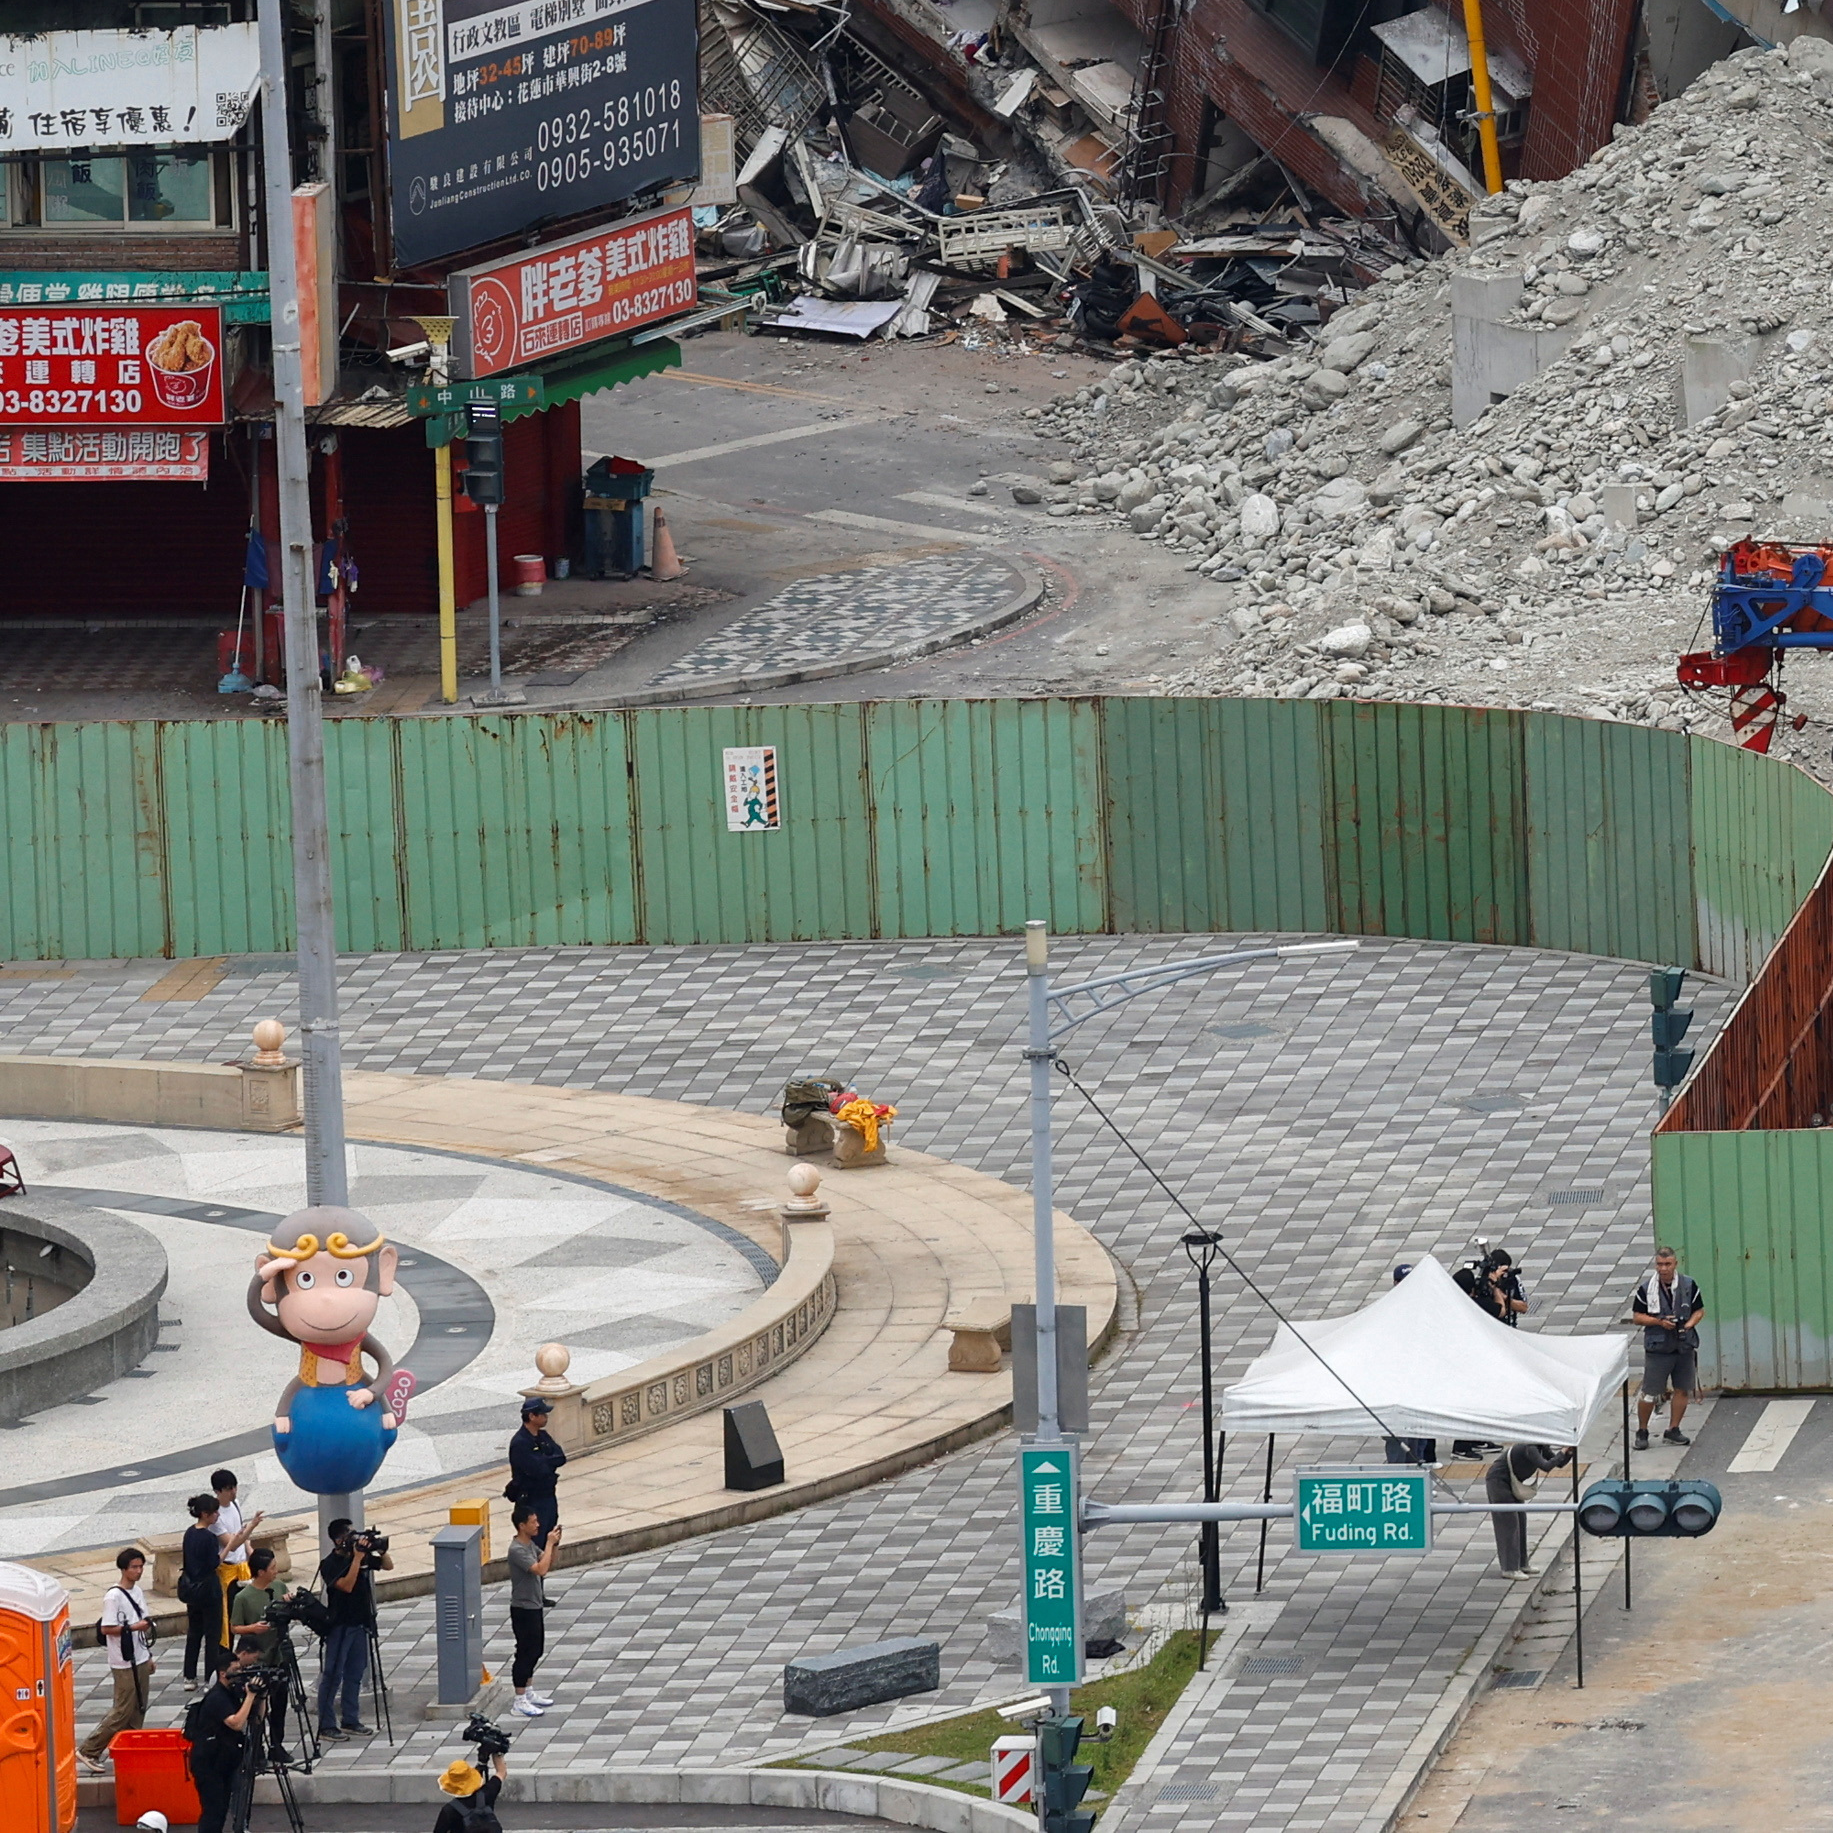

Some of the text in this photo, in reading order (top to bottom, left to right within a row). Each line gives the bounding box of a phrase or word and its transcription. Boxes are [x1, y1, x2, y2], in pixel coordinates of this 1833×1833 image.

[452, 11, 522, 56] 行政文教區
[452, 22, 628, 96] 地坪32-45坪 建坪70-89坪
[537, 78, 682, 153] 0932-581018
[536, 118, 682, 193] 0905-935071
[521, 246, 603, 324] 胖老爹
[604, 217, 691, 281] 美式炸雞
[612, 277, 693, 325] 03-8327130
[522, 314, 583, 354] 石來運轉店
[0, 360, 141, 386] 運轉店
[0, 389, 142, 414] 3-8327130
[436, 382, 517, 405] 中山路
[20, 429, 207, 464] 集點活動開跑了
[391, 1376, 412, 1419] 2020
[1311, 1483, 1413, 1515] 福町路
[1032, 1482, 1066, 1600] 重慶路
[1311, 1522, 1414, 1547] Fuding Rd.
[1028, 1621, 1072, 1652] Chongqing
[1042, 1655, 1061, 1676] Rd.
